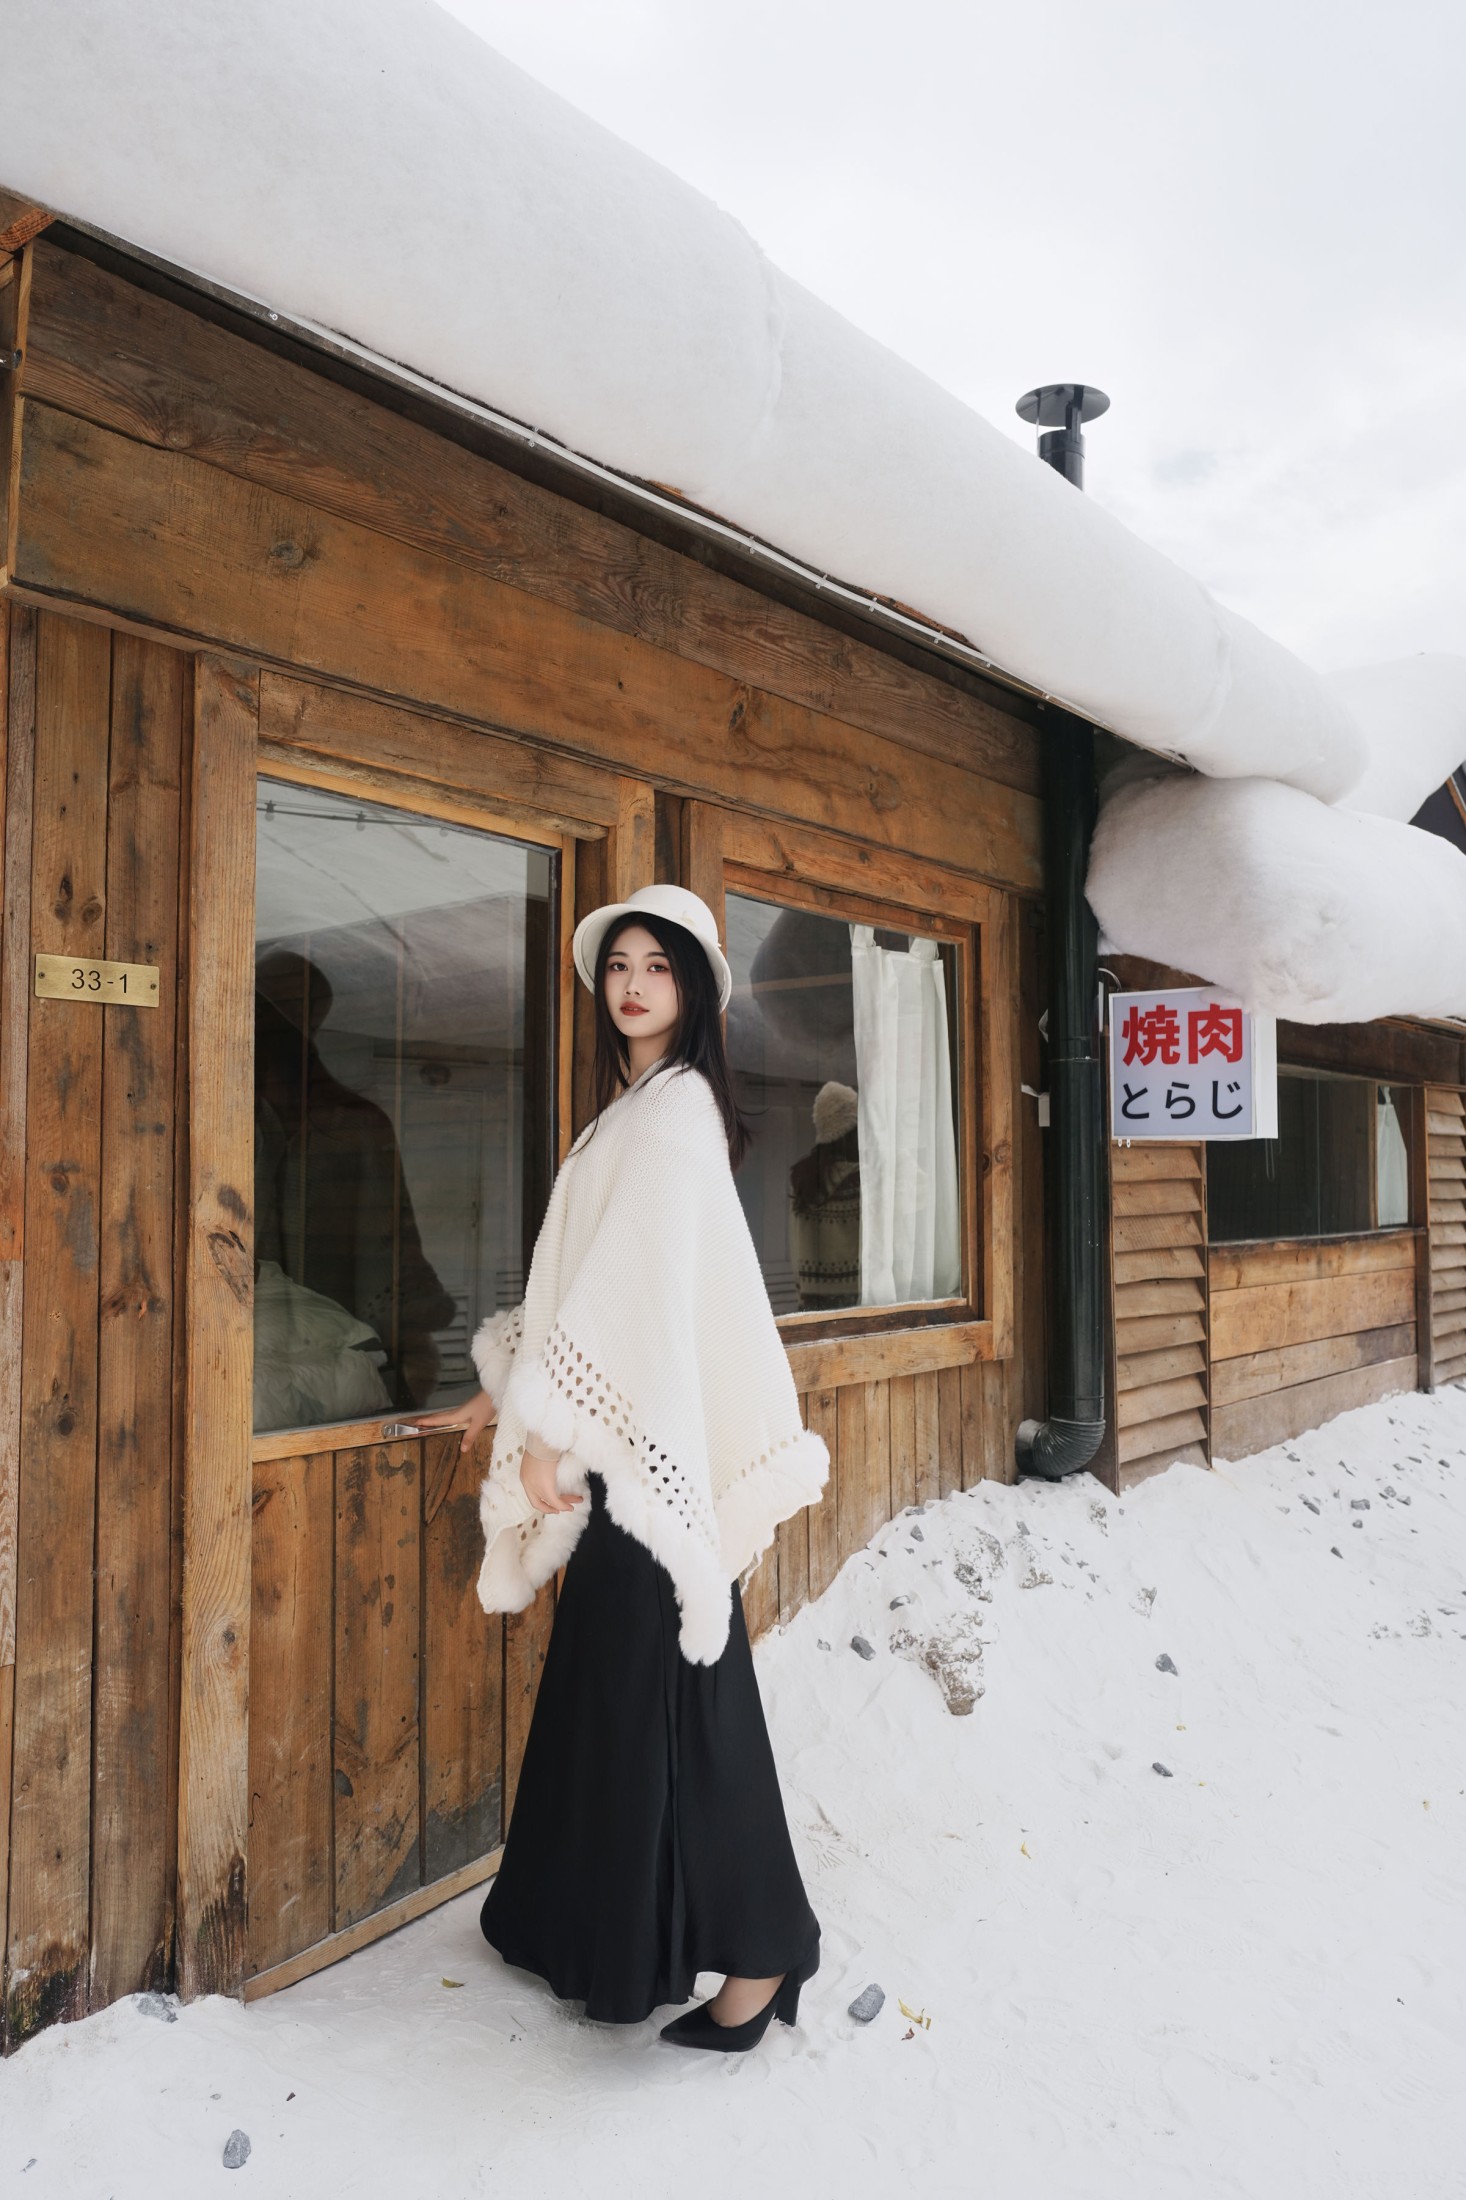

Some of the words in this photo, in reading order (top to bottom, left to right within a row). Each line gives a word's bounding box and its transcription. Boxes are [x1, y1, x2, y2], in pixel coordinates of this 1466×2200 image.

[71, 968, 127, 994] 33-1
[1122, 1003, 1243, 1066] 焼肉
[1122, 1080, 1243, 1120] とらじ
